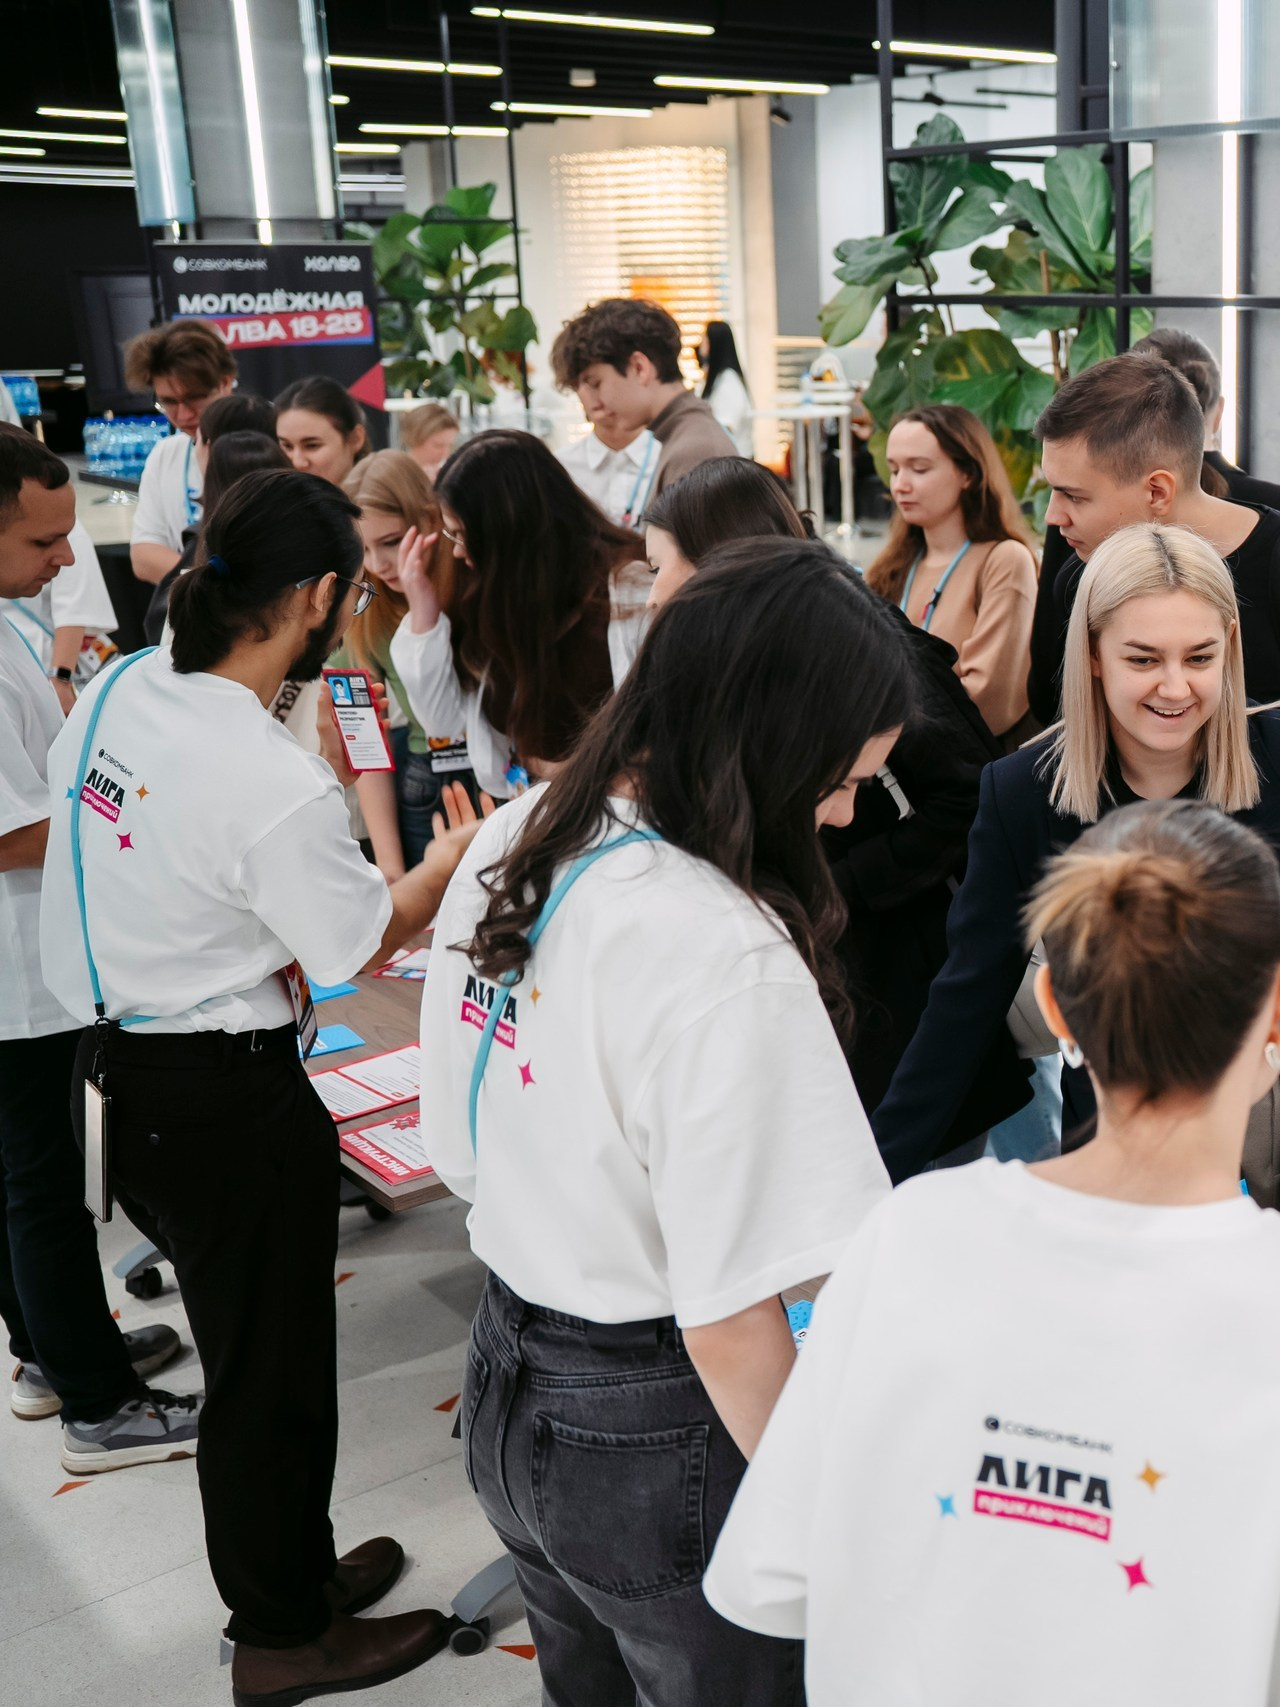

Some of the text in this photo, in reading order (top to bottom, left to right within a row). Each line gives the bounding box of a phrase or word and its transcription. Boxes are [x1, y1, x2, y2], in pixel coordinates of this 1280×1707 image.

[178, 288, 364, 314] МОЛОДЁЖНАЯ
[289, 312, 364, 338] 18-25
[103, 752, 134, 779] СОВКОМБАНК
[85, 768, 125, 808] ЛИГА
[463, 974, 517, 1024] ЛИА
[341, 1133, 411, 1177] ИНСТРУКЦИЯ
[976, 1453, 1112, 1510] ЛИГА
